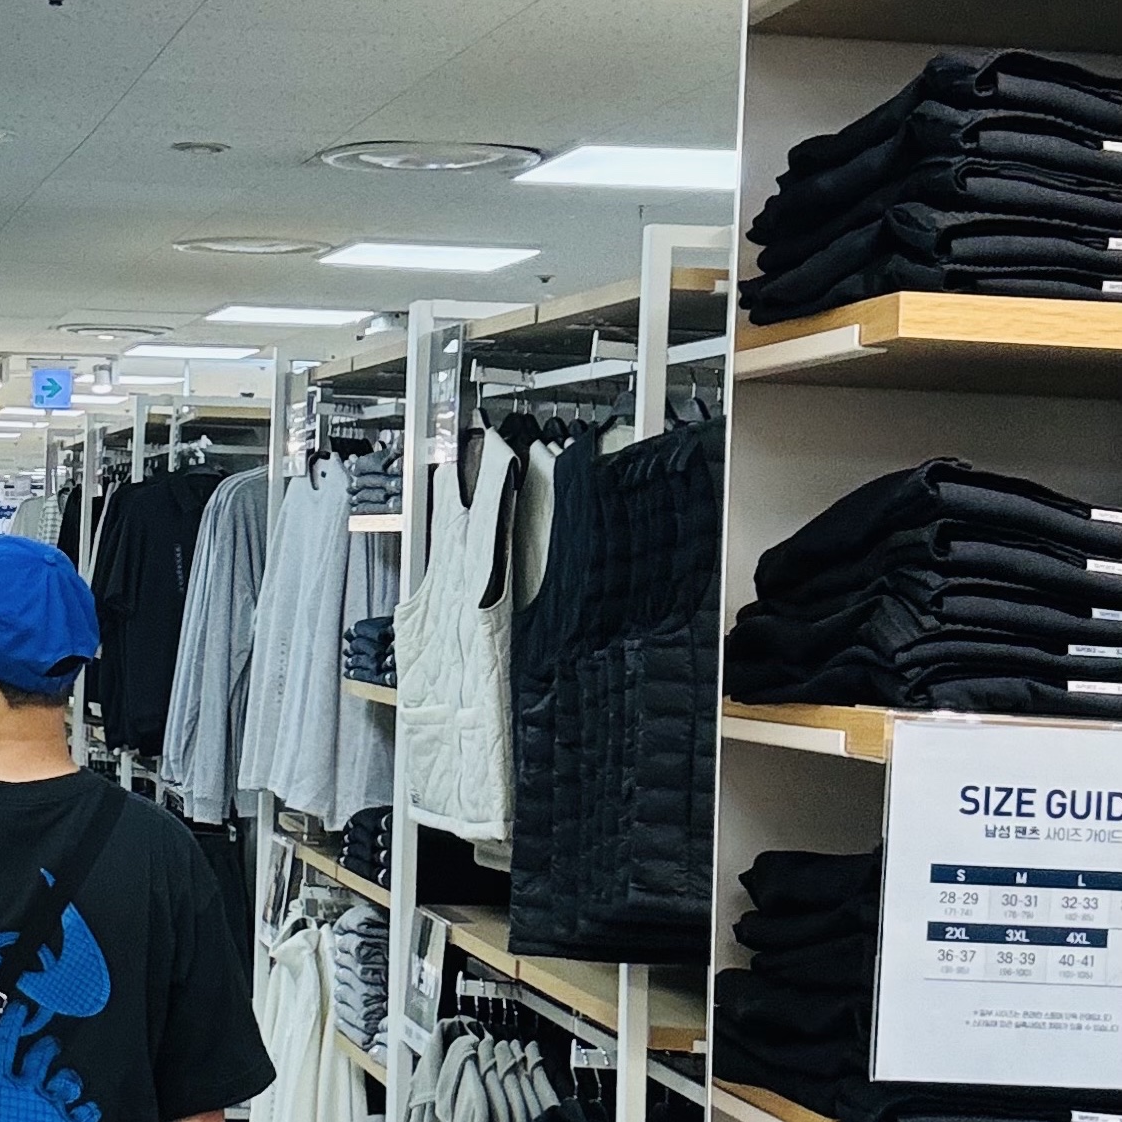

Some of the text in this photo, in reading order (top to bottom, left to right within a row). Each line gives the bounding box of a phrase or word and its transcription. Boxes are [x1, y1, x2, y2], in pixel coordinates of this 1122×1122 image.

[959, 785, 1122, 822] SIZE GUID
[985, 824, 1122, 844] 남성 팬츠 사이즈 가이드
[956, 869, 1086, 887] S M L
[939, 891, 1099, 910] 28-29 30-31 32-33
[944, 927, 1091, 945] 2XL 3XL 4XL
[937, 950, 1095, 967] 36-37 38-39 40-41
